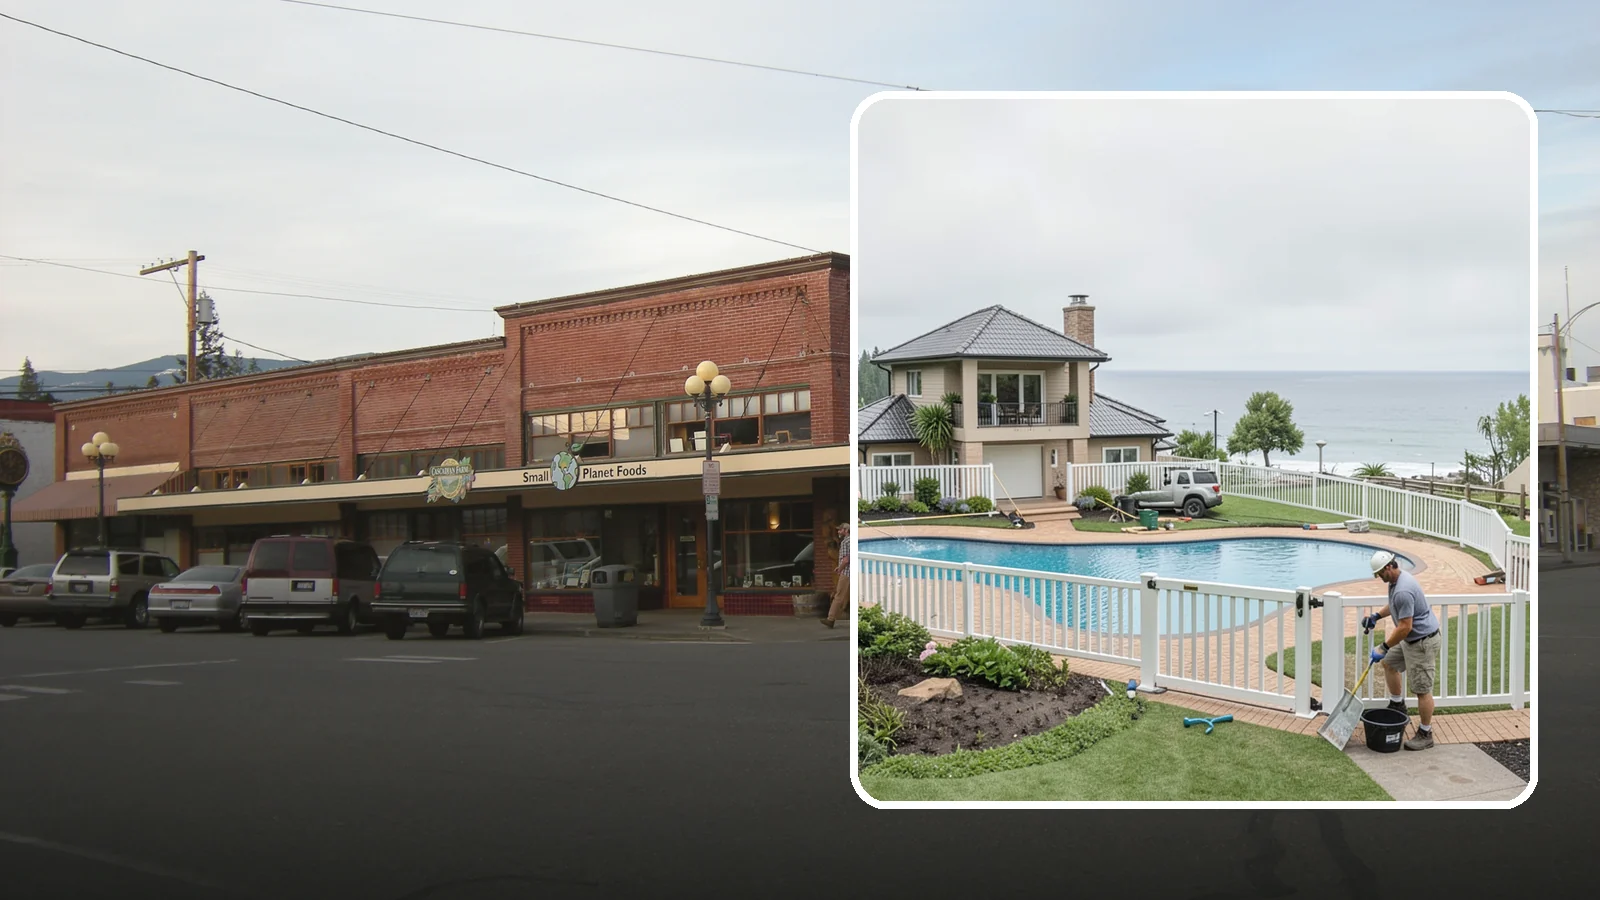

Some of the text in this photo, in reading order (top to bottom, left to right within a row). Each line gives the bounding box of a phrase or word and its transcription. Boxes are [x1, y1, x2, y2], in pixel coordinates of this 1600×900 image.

[523, 464, 647, 483] Small Planet Foods
